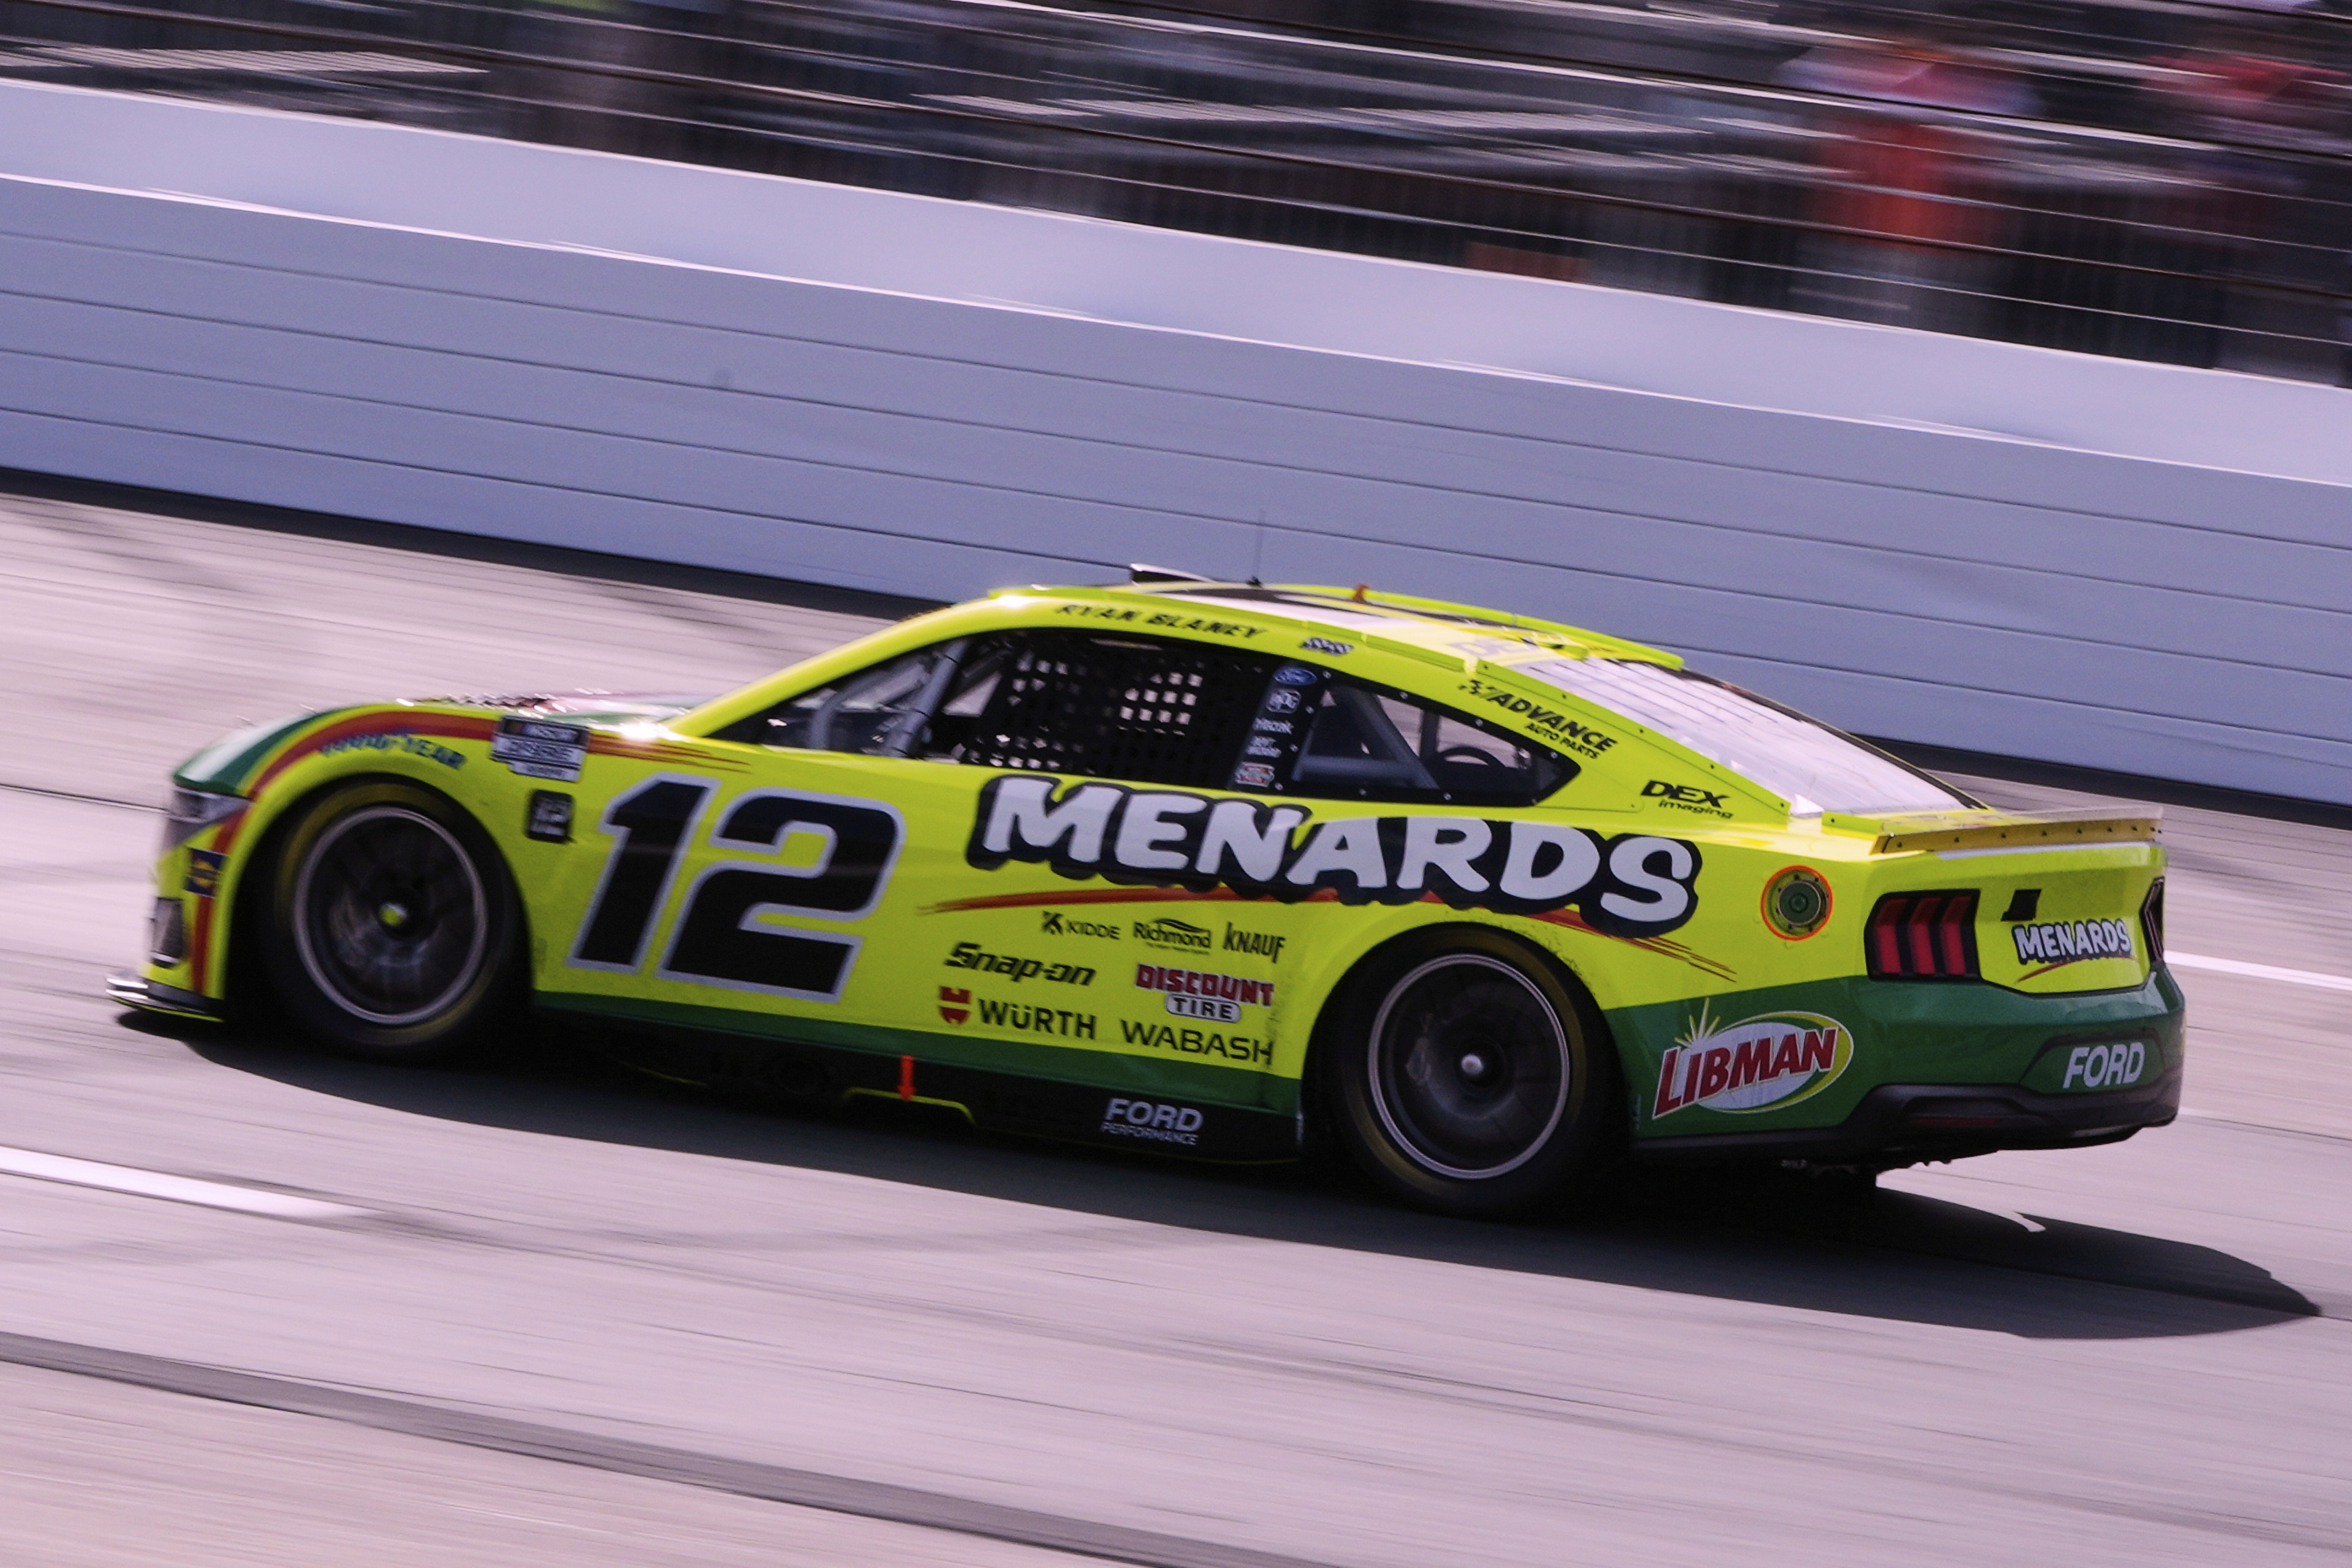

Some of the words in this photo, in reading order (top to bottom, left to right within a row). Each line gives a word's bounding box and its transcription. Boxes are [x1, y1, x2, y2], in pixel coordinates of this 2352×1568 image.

[1146, 613, 1267, 638] BLANEY
[1488, 687, 1618, 752] ADVANCE
[1524, 721, 1558, 743] AUTO
[1559, 735, 1600, 760] PARTS
[1641, 779, 1730, 808] DEX
[1659, 800, 1733, 819] imaging
[981, 776, 1693, 924] MENARDS
[567, 772, 905, 1003] 12
[1067, 920, 1121, 940] KIDDE
[1133, 920, 1211, 949] Richmond
[1223, 921, 1286, 963] KNAUF
[2016, 918, 2132, 961] MENARDS
[944, 941, 1096, 986] Snap-on
[1136, 963, 1274, 1007] DISCOUNT
[979, 999, 1096, 1040] WÜRTH
[1173, 996, 1232, 1020] TIRE
[1121, 1020, 1274, 1066] WABASH
[1653, 1027, 1838, 1120] LIBMAN
[2063, 1041, 2145, 1089] FORD
[1100, 1121, 1198, 1146] PERFORMANCE
[1105, 1098, 1203, 1133] FORD
